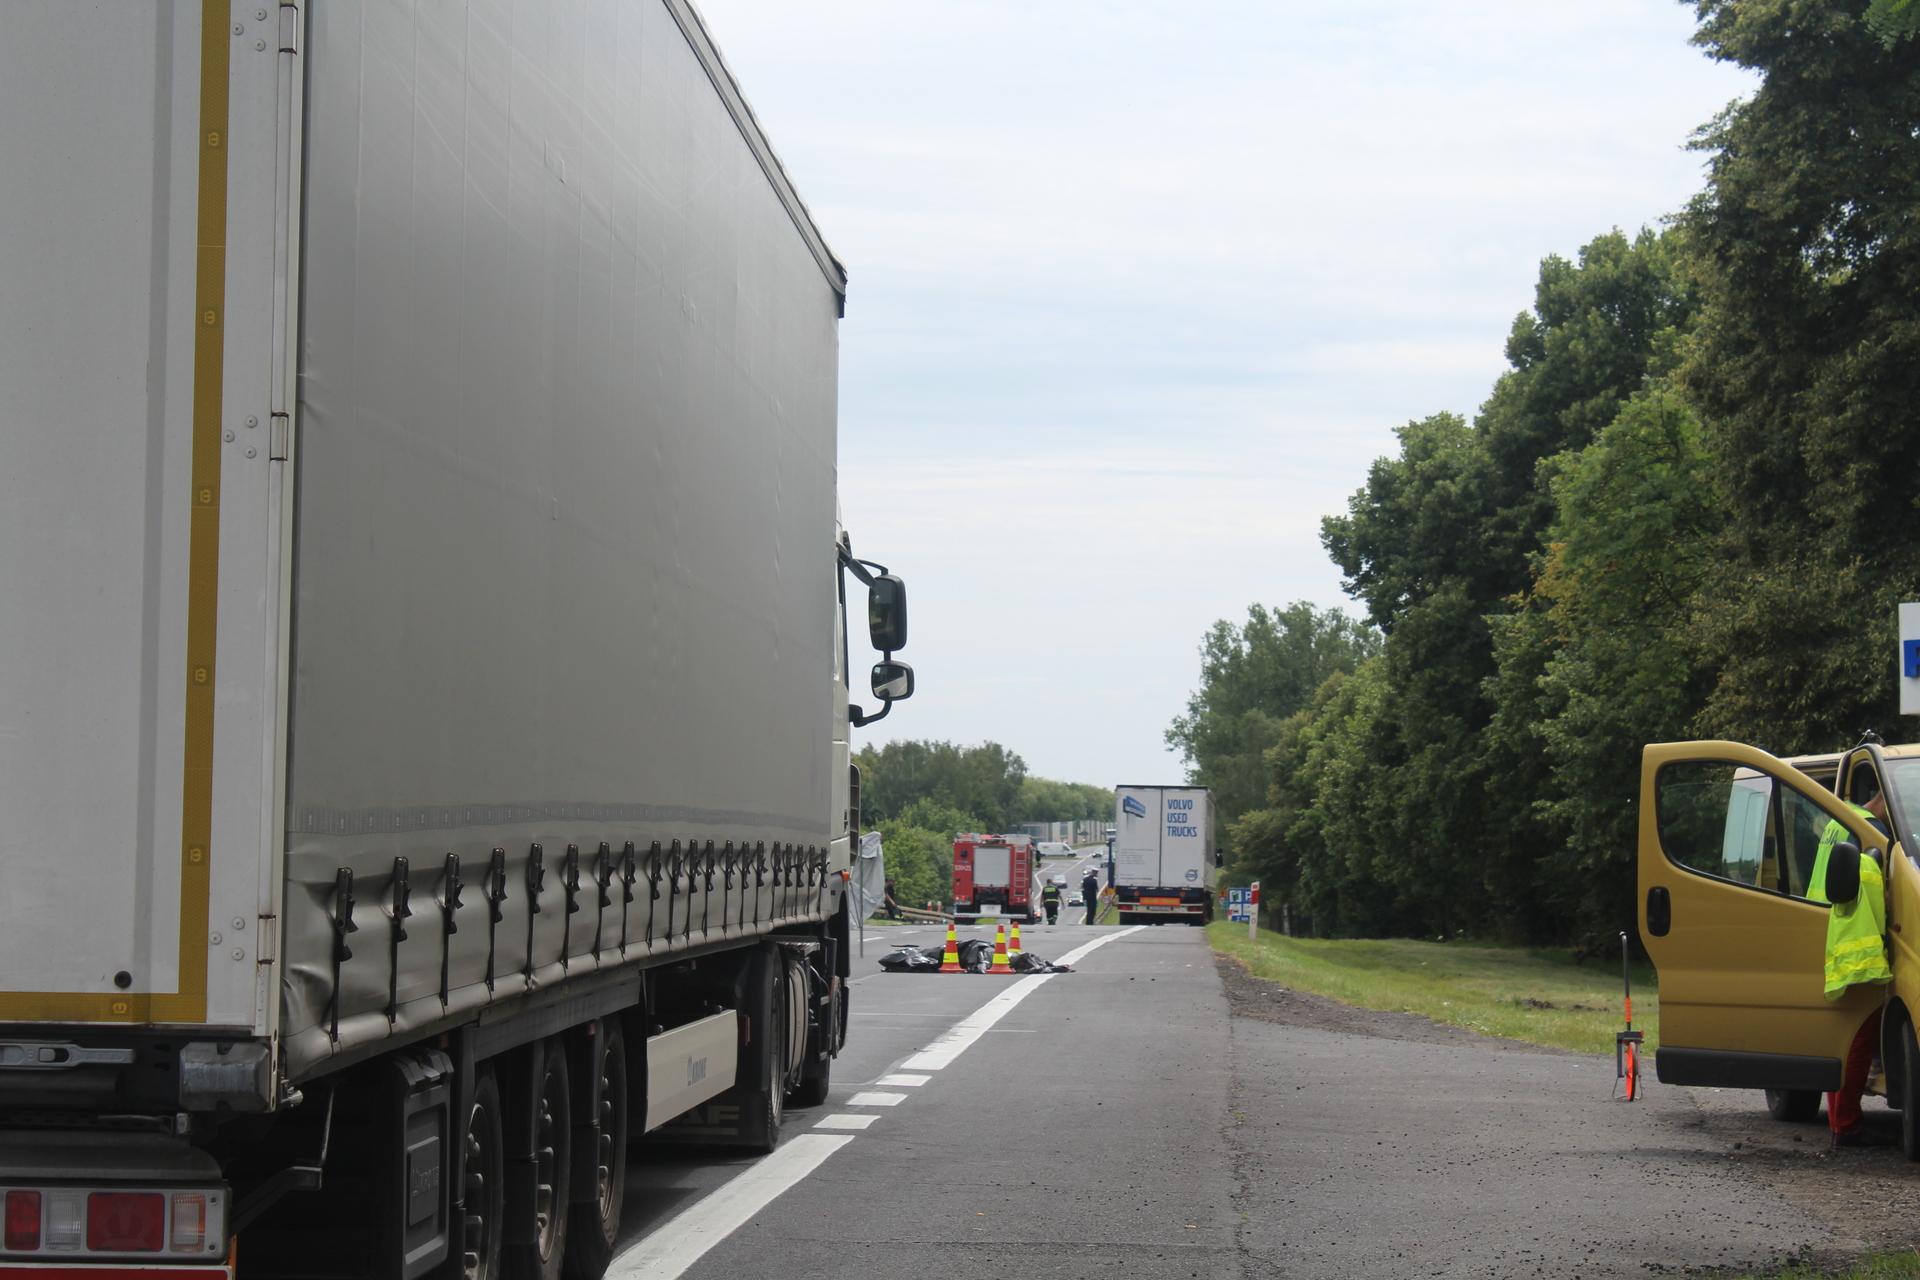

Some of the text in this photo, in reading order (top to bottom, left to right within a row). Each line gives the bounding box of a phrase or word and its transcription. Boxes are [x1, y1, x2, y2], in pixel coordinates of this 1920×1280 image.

[1167, 799, 1193, 810] VOLVO
[1167, 813, 1188, 824] USED
[1167, 826, 1197, 837] TRUCKS
[692, 1057, 707, 1085] KRONE
